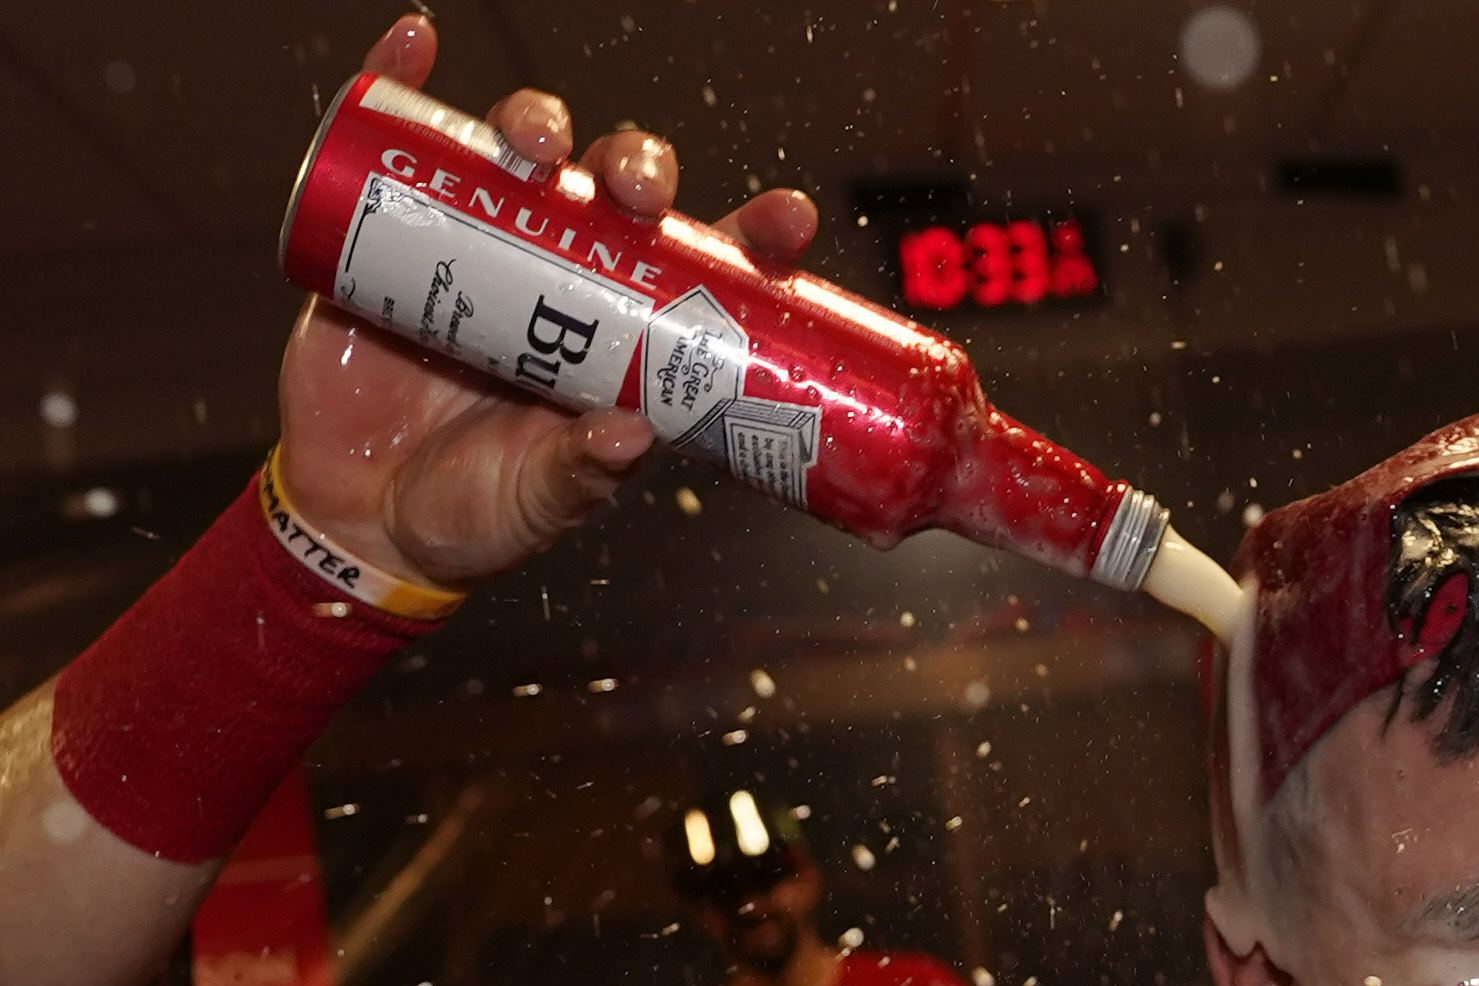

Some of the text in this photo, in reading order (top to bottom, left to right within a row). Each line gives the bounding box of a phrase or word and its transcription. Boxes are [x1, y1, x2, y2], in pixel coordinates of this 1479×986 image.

[381, 148, 663, 290] GENUINE
[515, 294, 600, 390] Bu
[680, 361, 710, 413] GREAT
